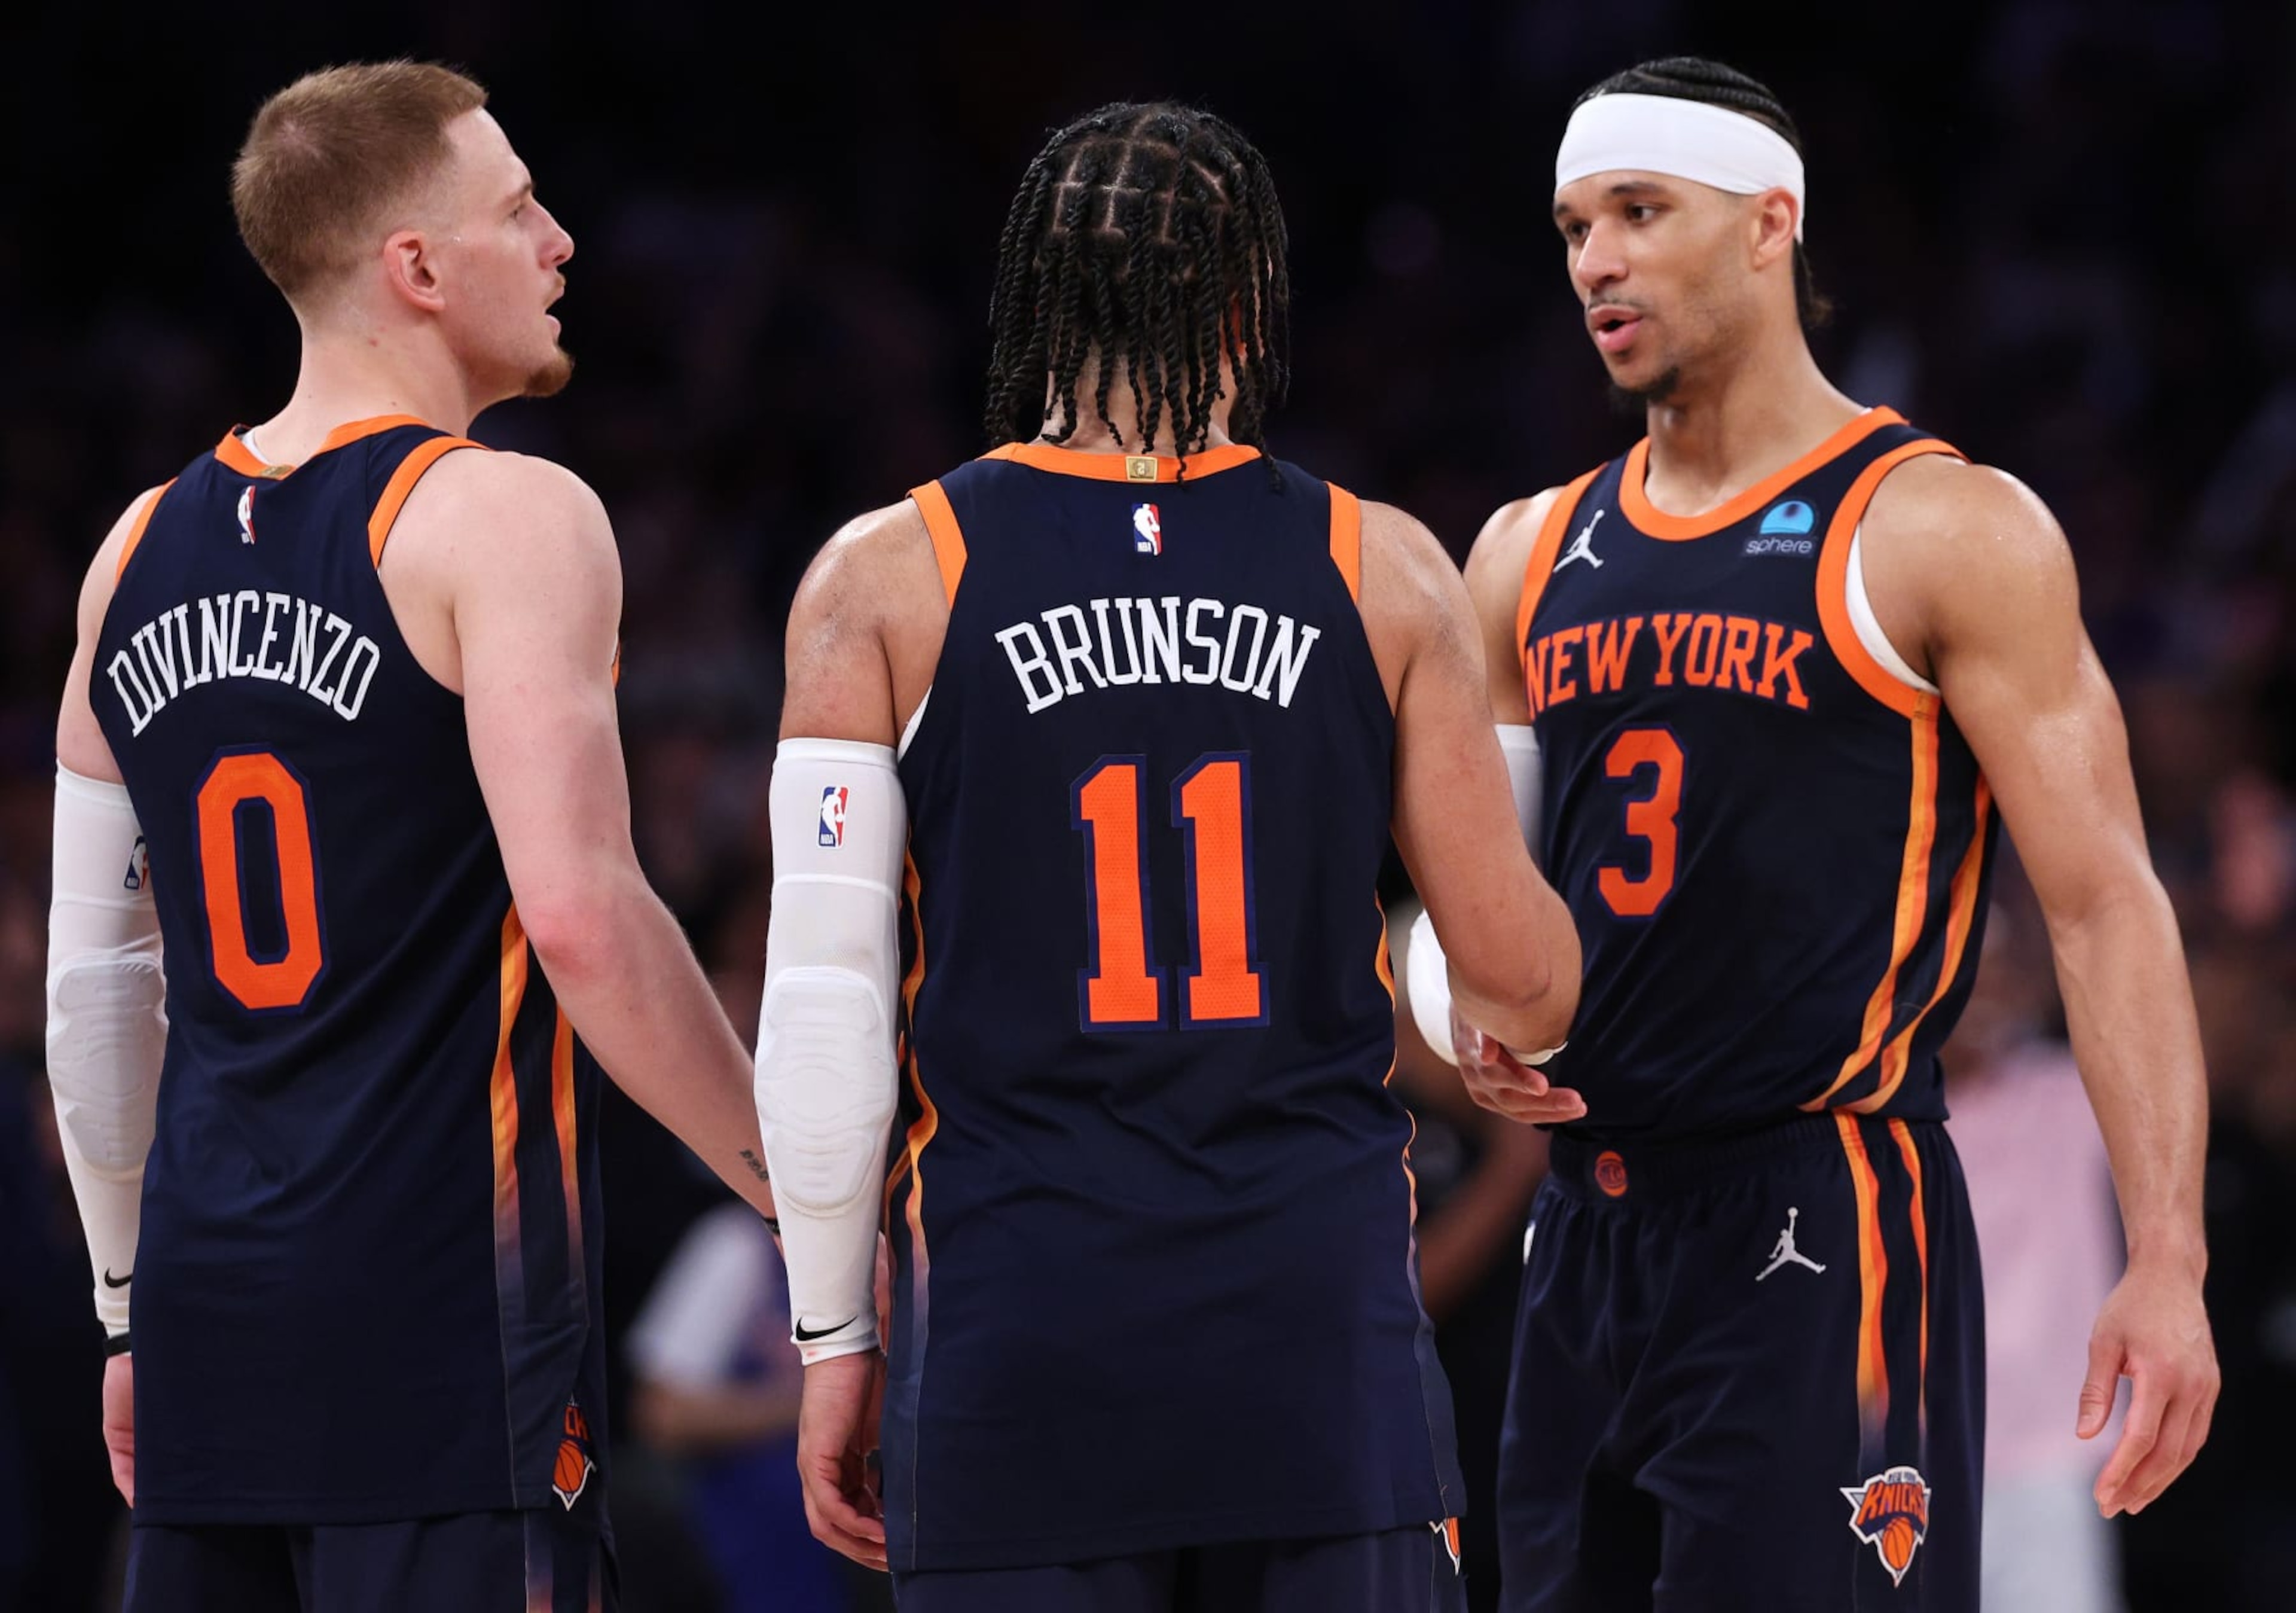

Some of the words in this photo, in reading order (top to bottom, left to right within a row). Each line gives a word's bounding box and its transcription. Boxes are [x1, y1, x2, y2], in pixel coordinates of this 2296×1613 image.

[1746, 537, 1812, 554] sphere
[106, 590, 380, 737] DIVINCENZO
[994, 596, 1321, 714] BRUNSON
[1526, 617, 1644, 720] NEW
[1651, 612, 1814, 710] YORK
[196, 751, 323, 1010] 0
[1079, 760, 1260, 1023] 11
[1598, 728, 1684, 916] 3
